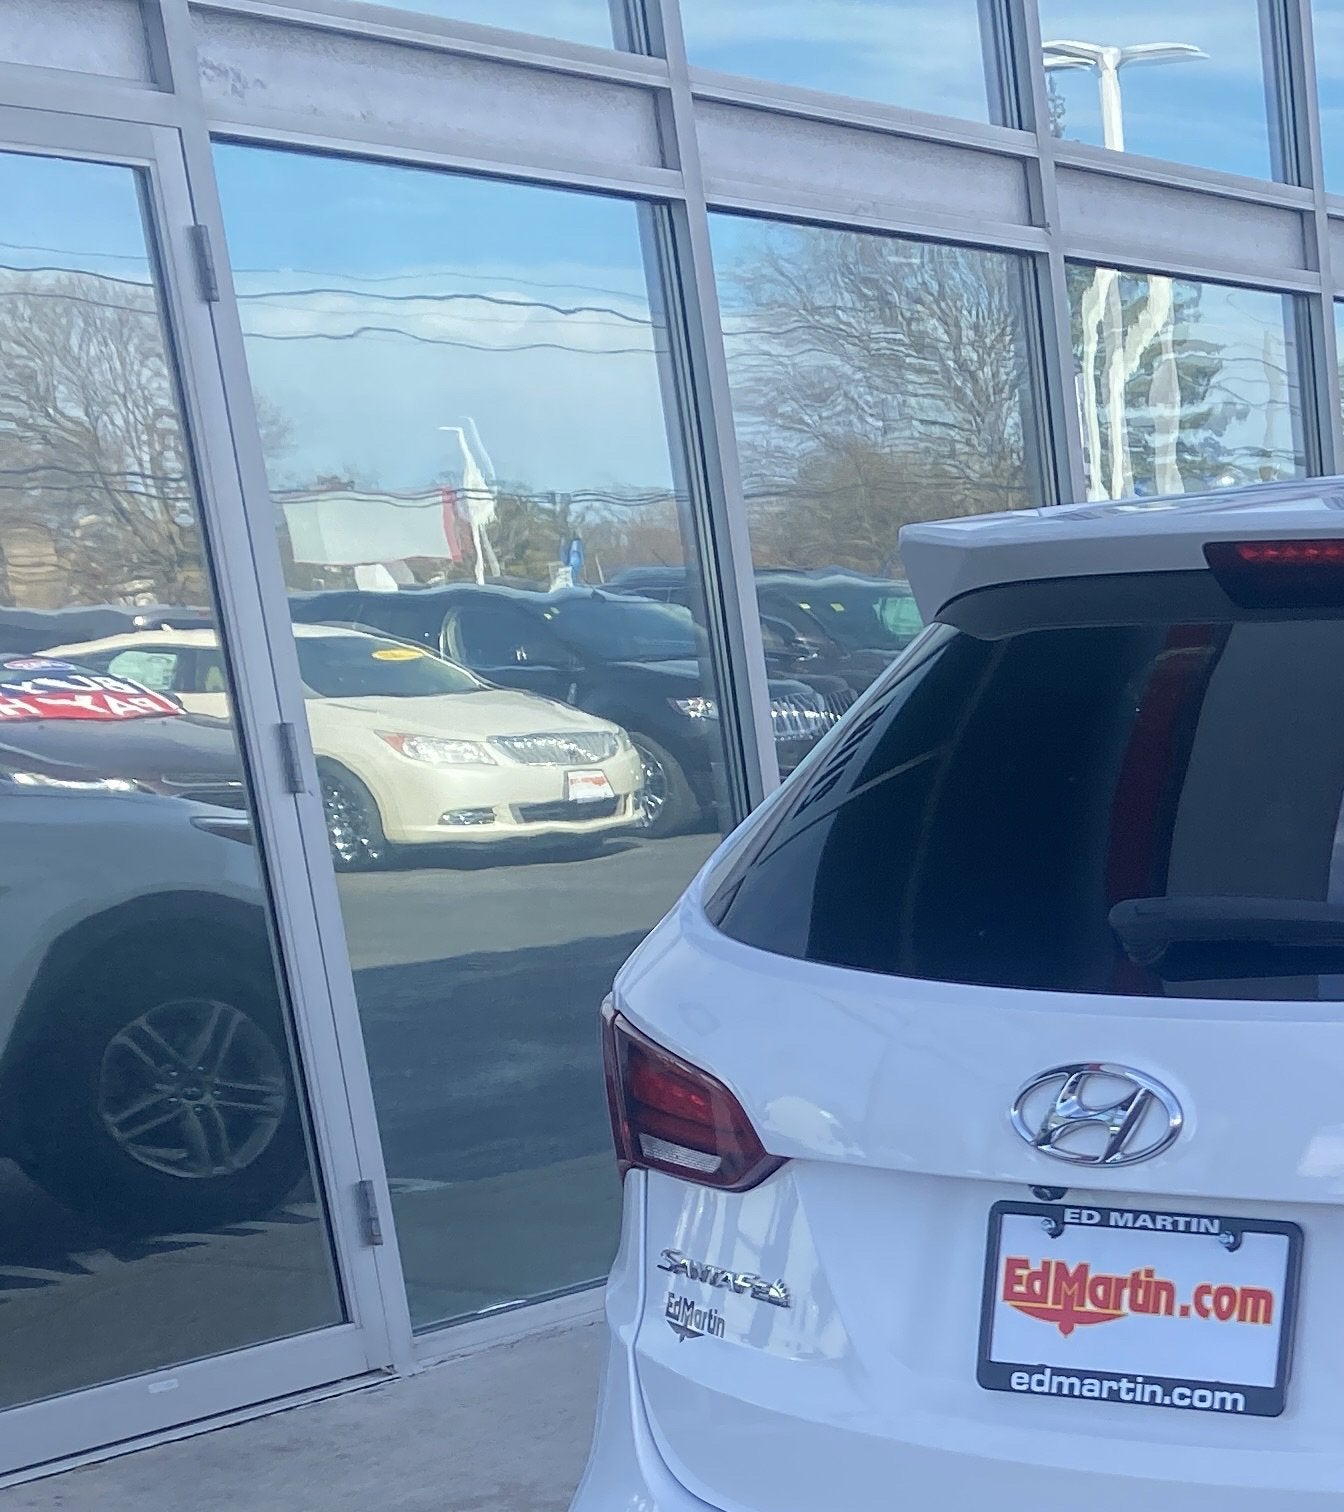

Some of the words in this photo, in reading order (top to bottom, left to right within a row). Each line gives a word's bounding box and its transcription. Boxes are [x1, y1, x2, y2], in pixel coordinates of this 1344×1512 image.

[1063, 1207, 1101, 1225] ED
[1109, 1211, 1220, 1234] MARTIN
[1003, 1255, 1274, 1327] EdMartin.com
[665, 1291, 725, 1338] EdMartin
[1010, 1368, 1246, 1412] edmartin.com
